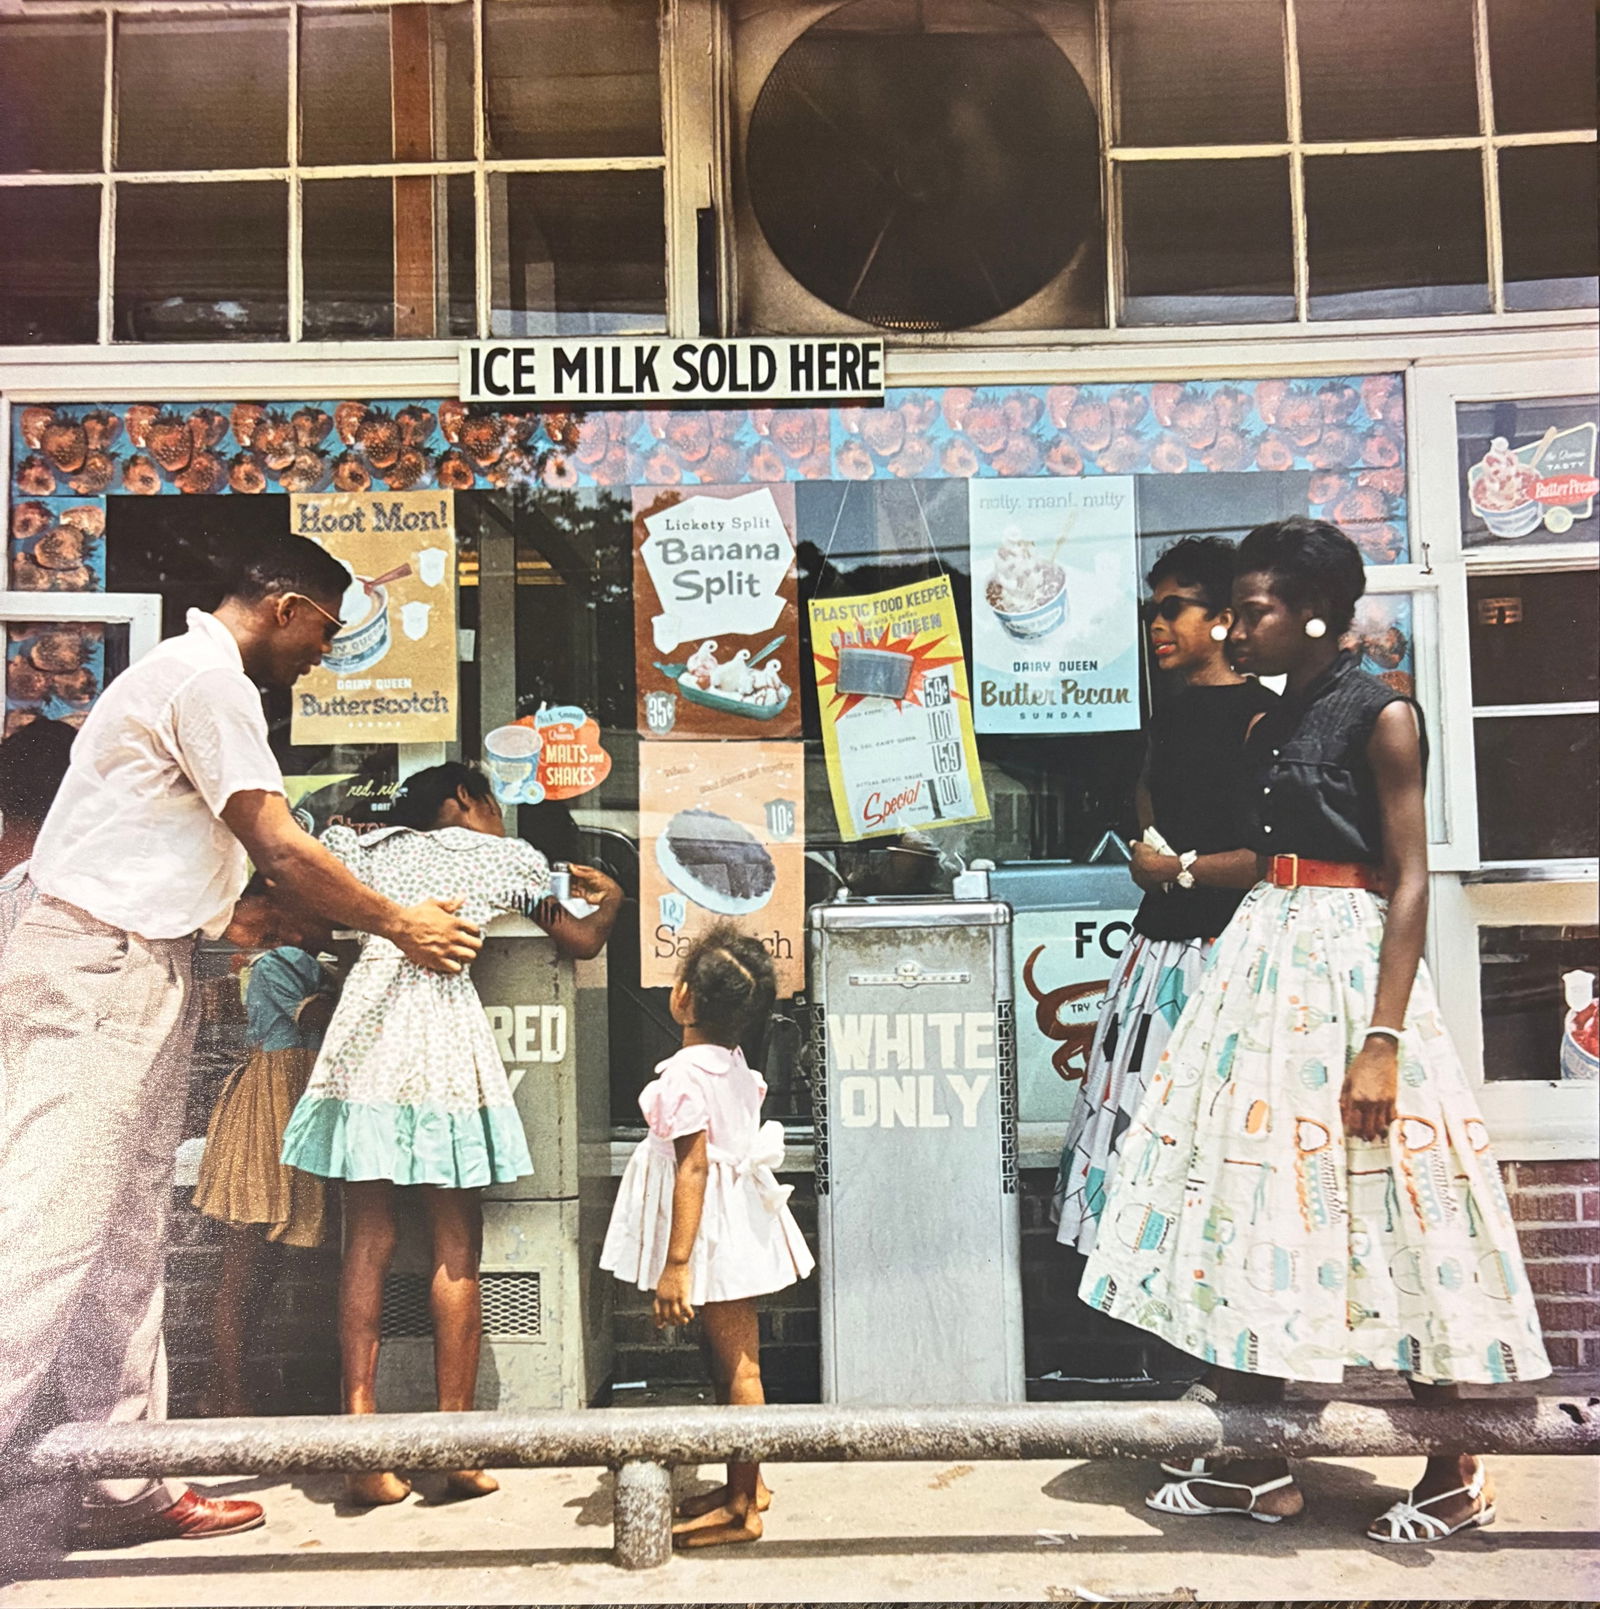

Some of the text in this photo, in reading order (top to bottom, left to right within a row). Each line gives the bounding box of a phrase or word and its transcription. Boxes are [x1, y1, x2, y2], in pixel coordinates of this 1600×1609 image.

[469, 342, 882, 396] ICE MILK SOLD HERE
[298, 500, 448, 533] Hoot Mon!
[665, 516, 771, 533] Lickety Split
[655, 538, 780, 566] Banana
[672, 569, 762, 605] Split
[813, 584, 950, 622] PLASTIC FOOD KEEPER
[891, 613, 943, 639] QUEEN
[1012, 660, 1098, 673] DAIRY QUEEN
[336, 678, 413, 691] DAIRY QUEEN
[925, 676, 949, 707] 59¢
[980, 678, 1132, 707] Butter Pecan
[299, 689, 450, 717] Butterscotch
[649, 697, 674, 728] 35¢
[1019, 712, 1094, 720] SUNDAE
[546, 744, 604, 764] MALTS and
[346, 779, 375, 797] red,
[546, 767, 595, 786] SHAKES
[862, 779, 921, 828] Special
[771, 804, 794, 836] 10¢
[1071, 1003, 1090, 1013] TRY
[827, 1011, 997, 1071] WHITE
[840, 1074, 992, 1129] ONLY
